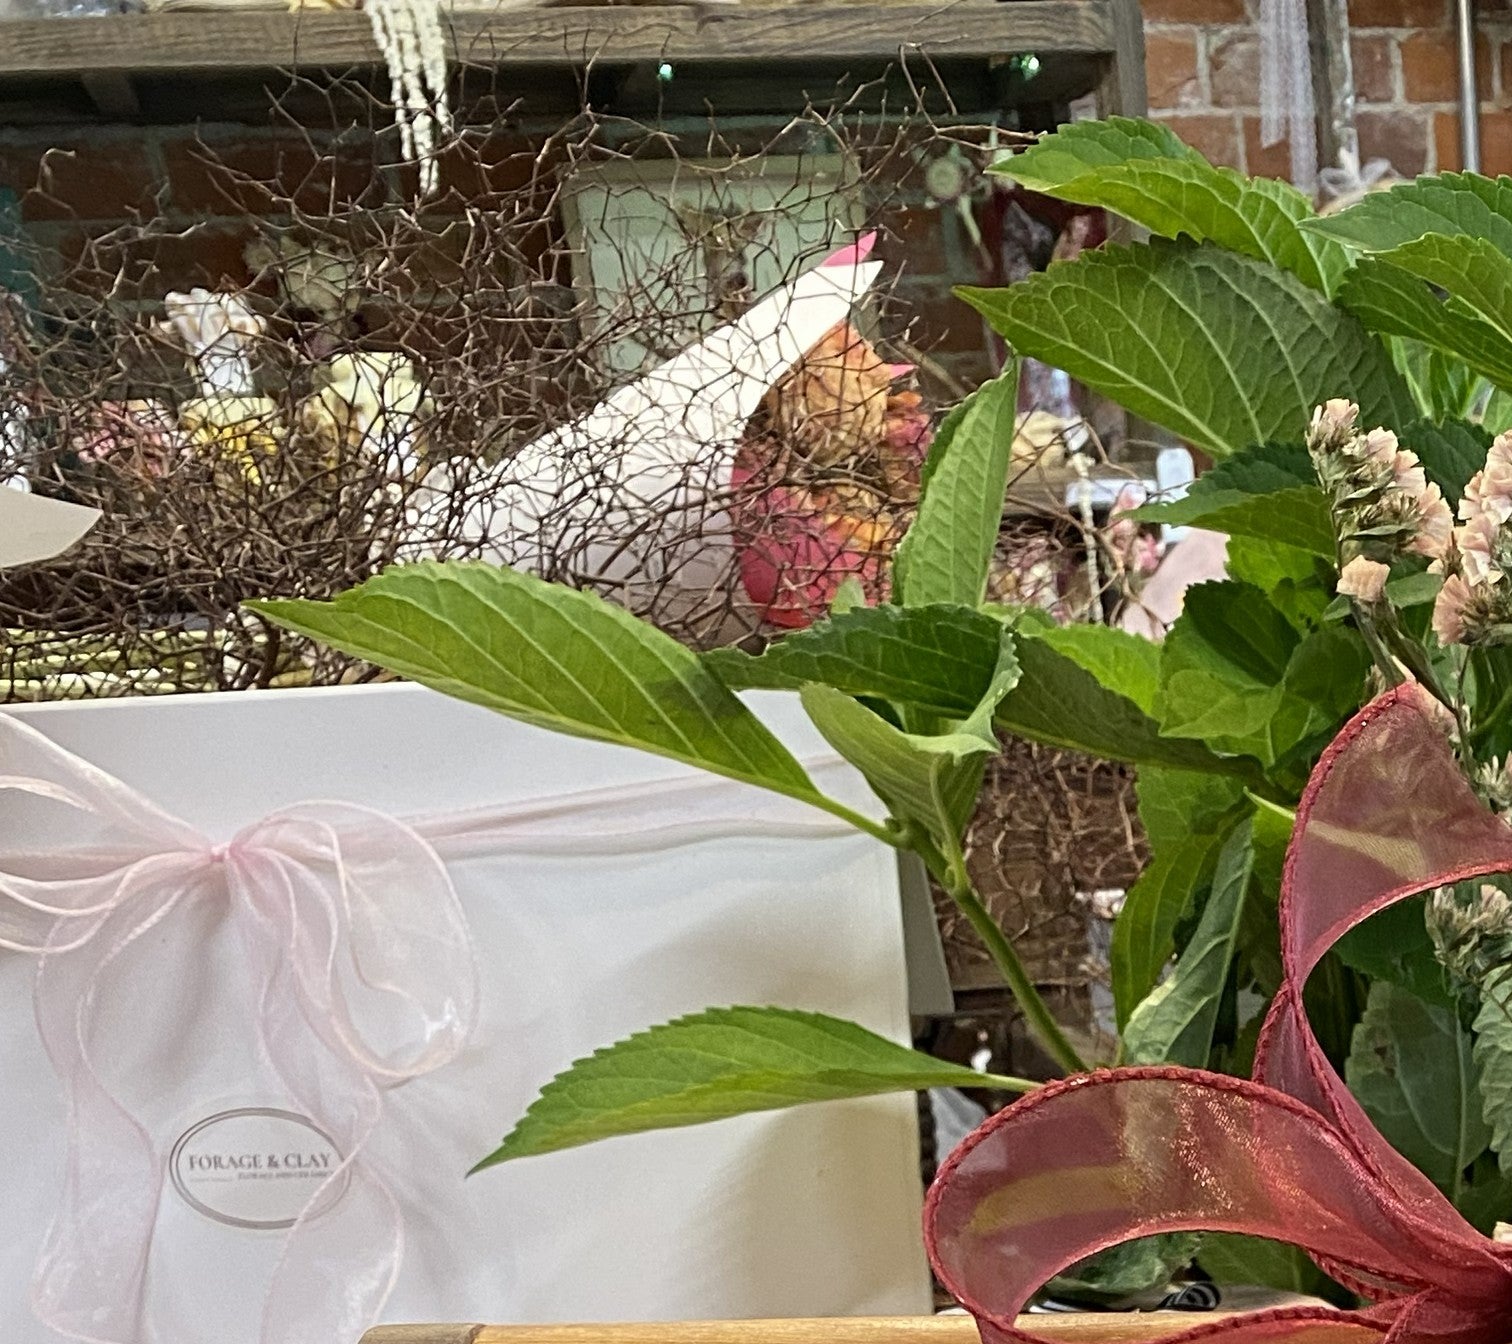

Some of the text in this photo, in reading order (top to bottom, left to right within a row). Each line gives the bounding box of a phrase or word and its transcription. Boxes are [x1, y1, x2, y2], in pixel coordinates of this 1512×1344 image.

[189, 1151, 331, 1171] FORAGE & CLAY
